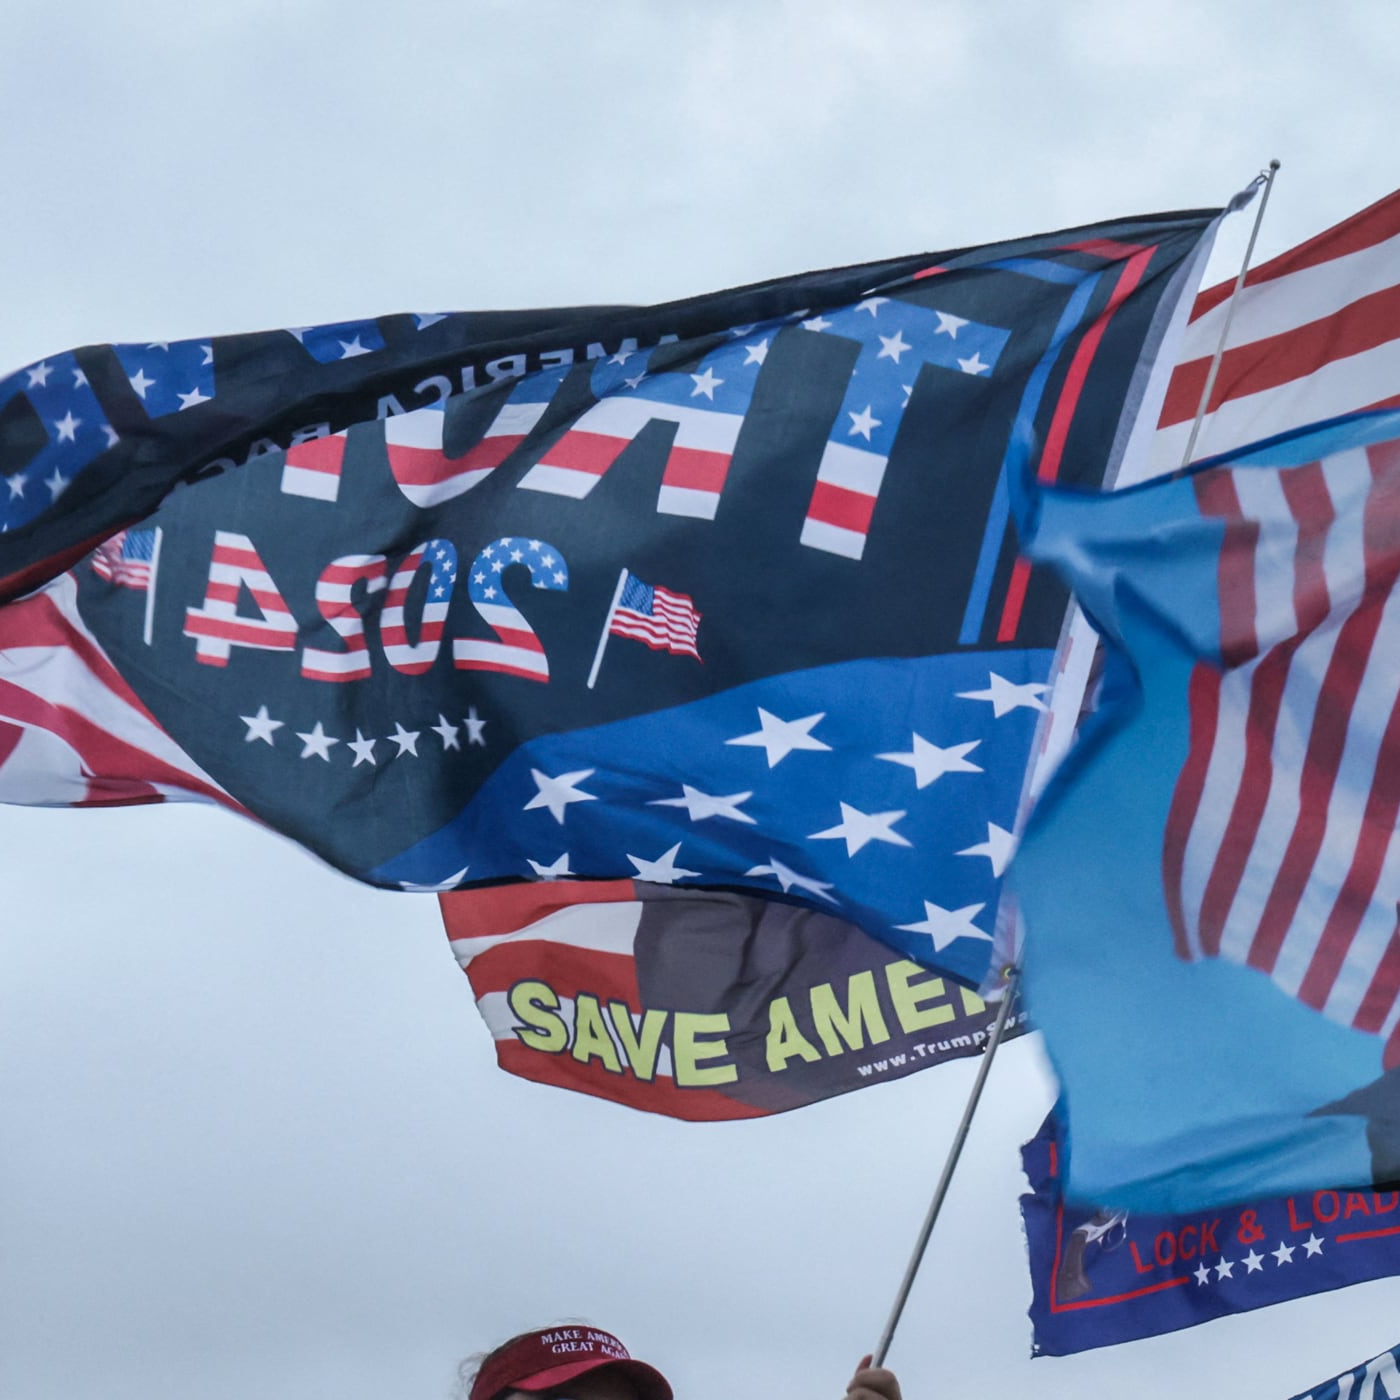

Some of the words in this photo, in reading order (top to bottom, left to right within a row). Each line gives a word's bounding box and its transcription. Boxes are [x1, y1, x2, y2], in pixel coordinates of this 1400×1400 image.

[508, 977, 738, 1087] SAVE
[1129, 1222, 1220, 1273] LOCK
[1237, 1210, 1267, 1243] &
[1287, 1190, 1399, 1231] LOAD
[541, 1330, 582, 1344] MAKE
[552, 1341, 594, 1353] GREAT
